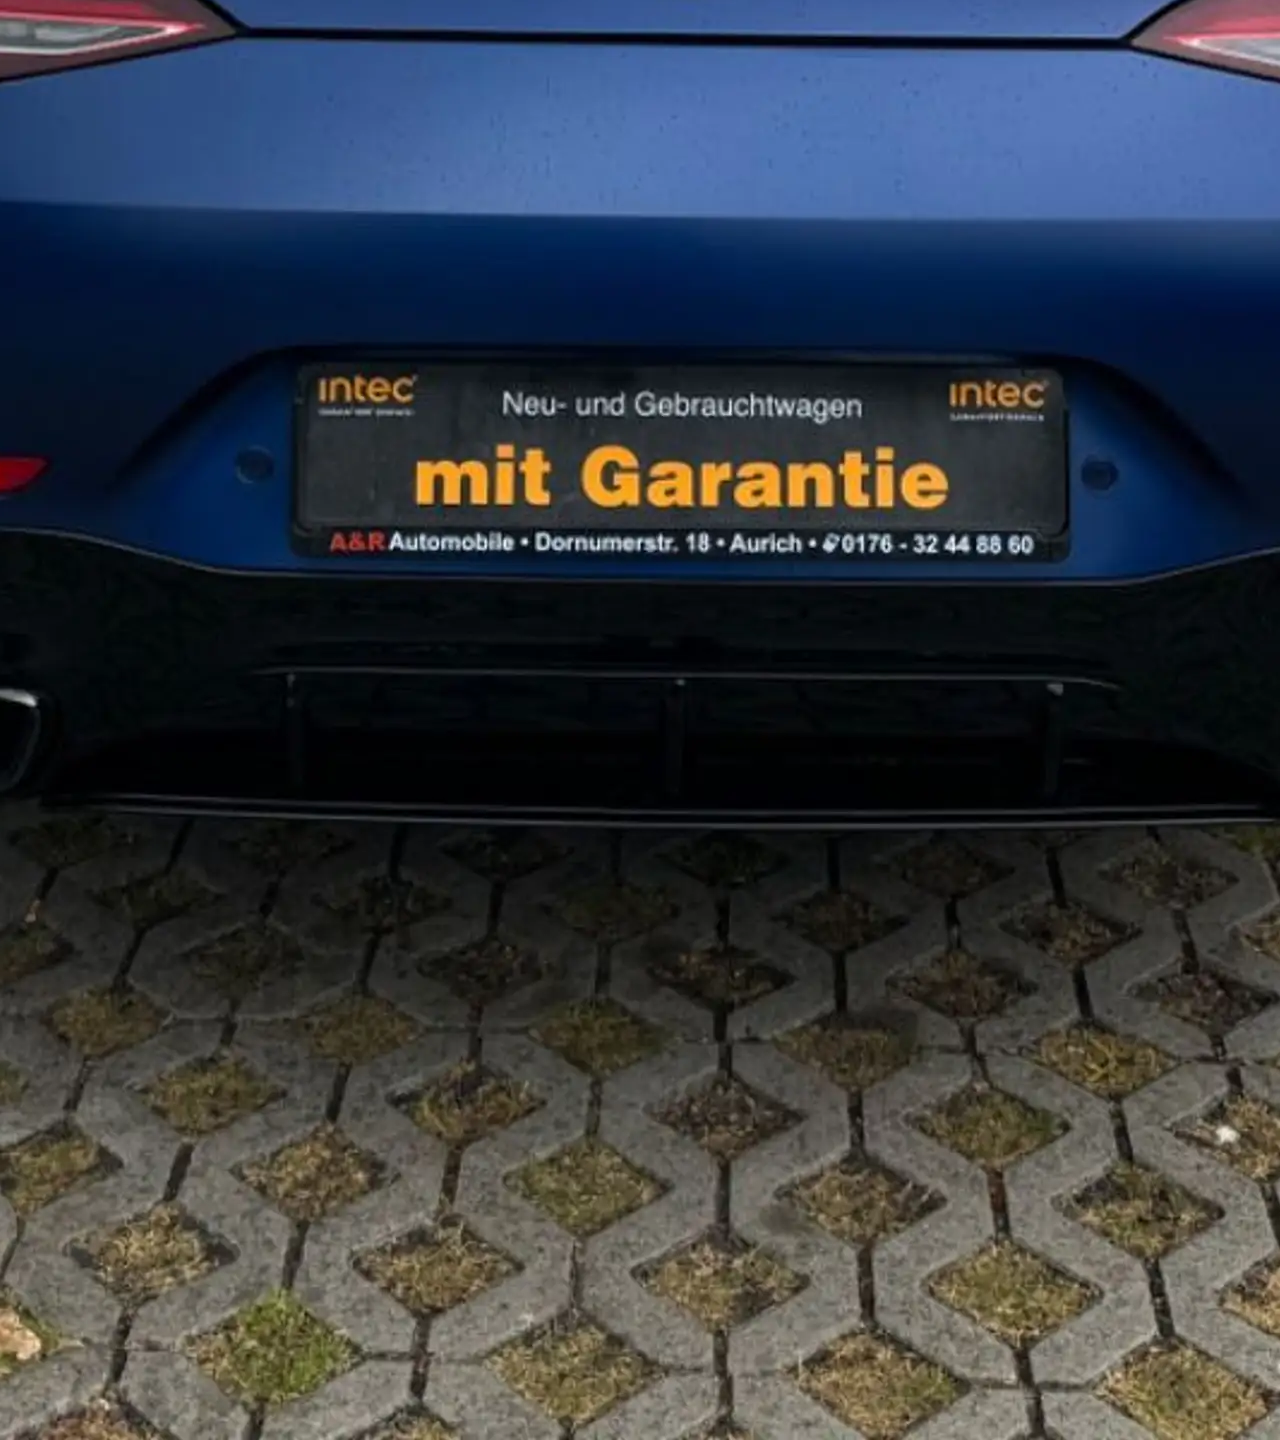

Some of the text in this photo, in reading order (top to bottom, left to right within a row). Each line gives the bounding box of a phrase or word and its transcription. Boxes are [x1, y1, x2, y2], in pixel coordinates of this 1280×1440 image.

[319, 375, 414, 403] intec
[950, 381, 1045, 408] intec
[502, 390, 863, 425] Neu- und Gebrauchtwagen
[416, 444, 949, 510] mit Garantie
[329, 532, 385, 554] A&R
[387, 531, 515, 554] Automobile
[535, 531, 679, 555] Dornumerstr.
[685, 532, 711, 554] 18
[729, 532, 803, 555] Aurich
[841, 533, 894, 556] 0176
[913, 534, 939, 556] 32
[944, 534, 971, 556] 44
[1007, 534, 1035, 556] 60
